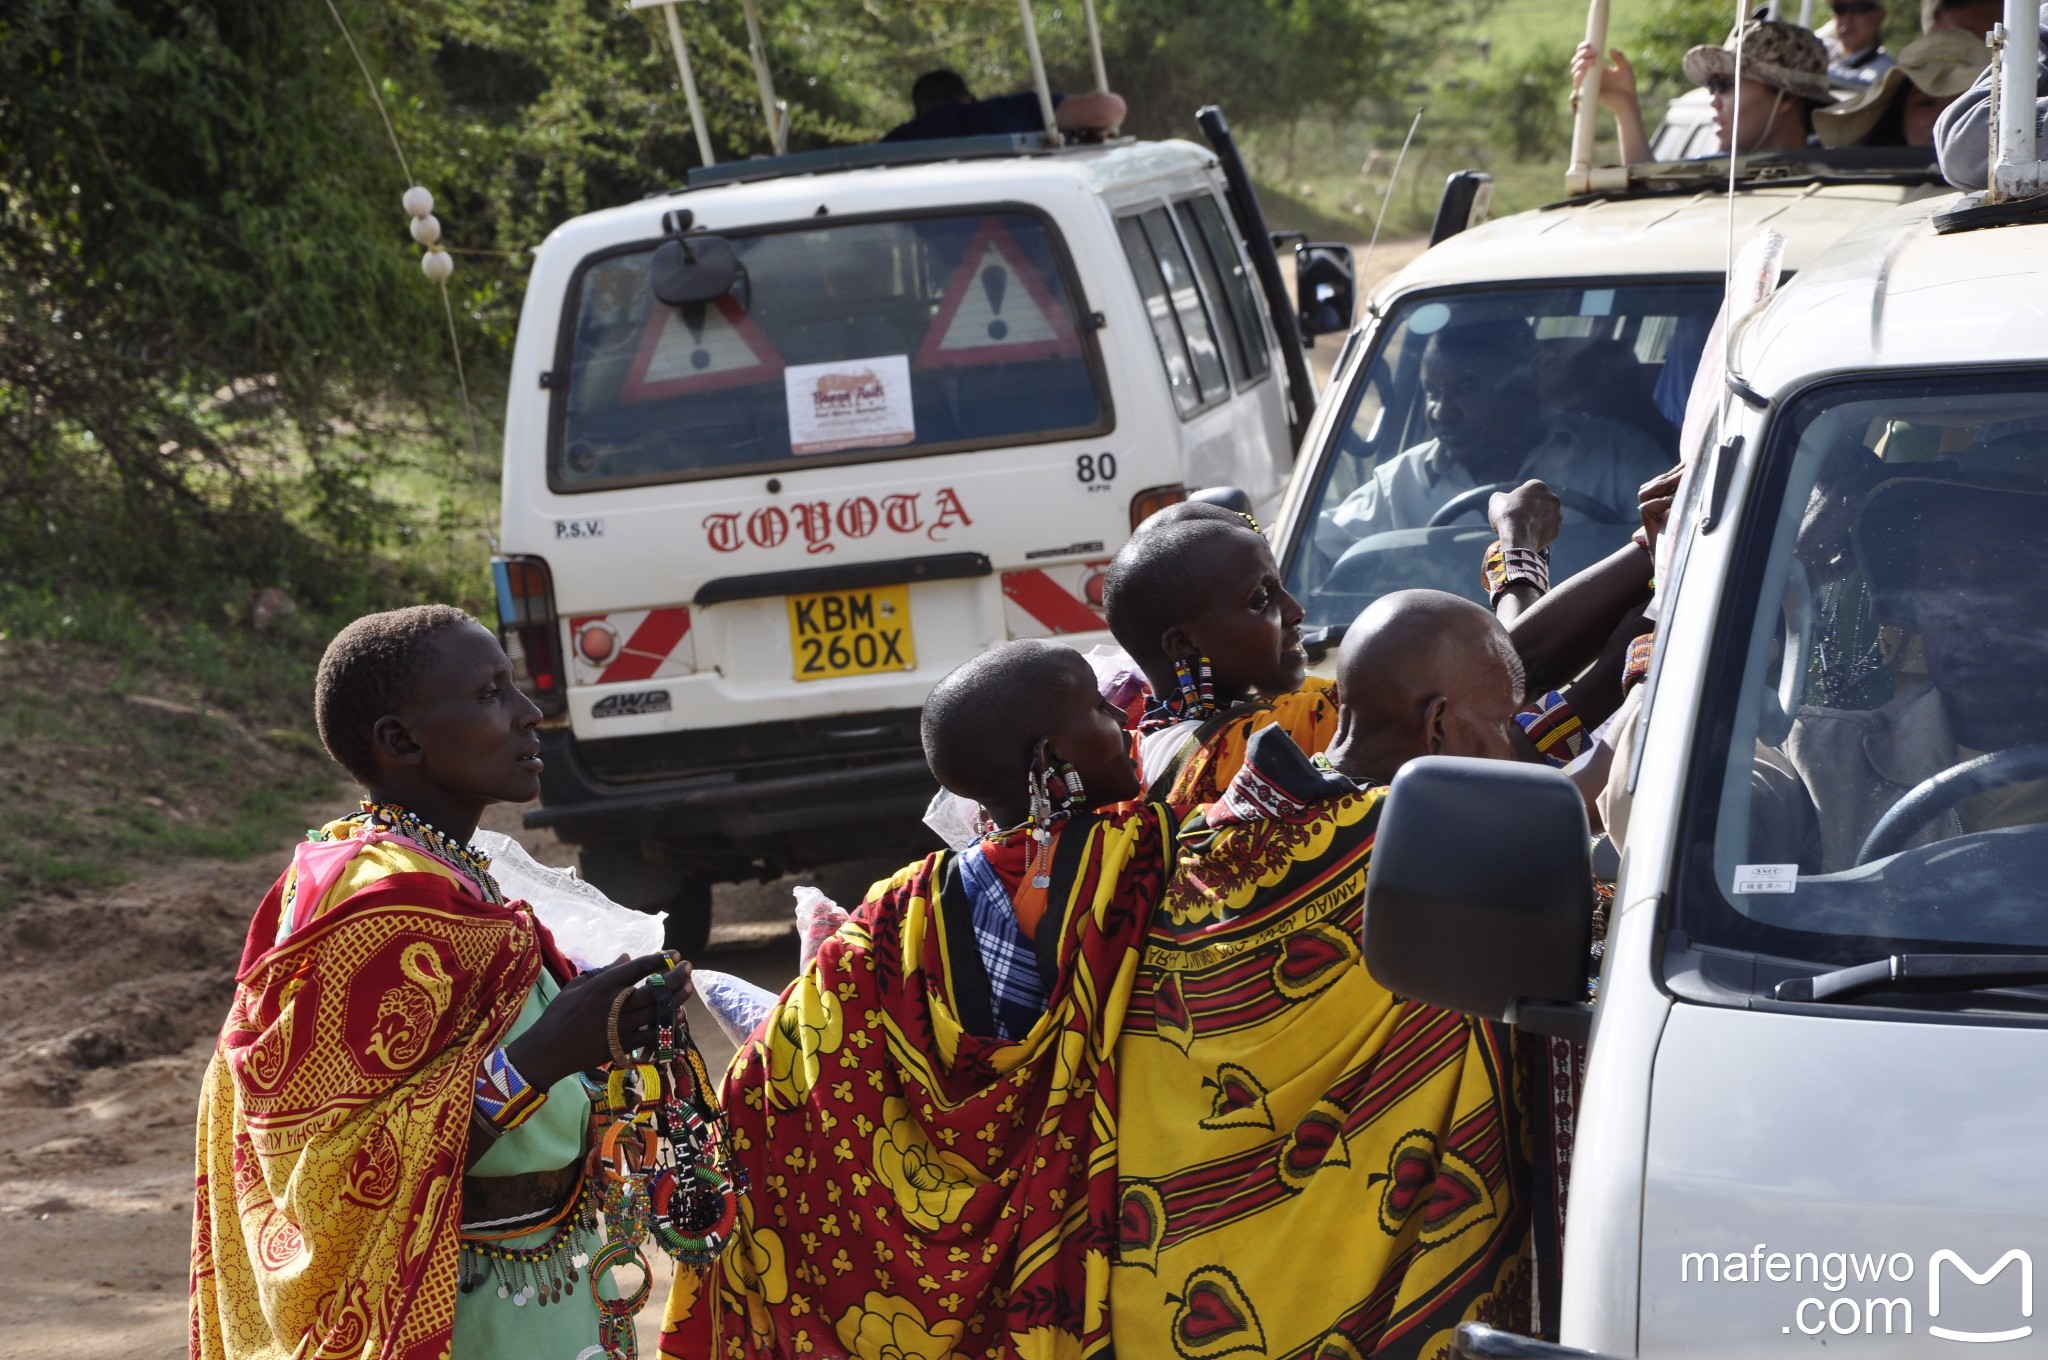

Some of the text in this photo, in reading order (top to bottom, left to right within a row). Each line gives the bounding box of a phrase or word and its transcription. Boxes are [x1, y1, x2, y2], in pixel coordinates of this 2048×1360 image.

[1076, 452, 1117, 483] 80
[555, 520, 603, 539] P.S.V.
[702, 487, 974, 554] TOYOTA
[794, 593, 875, 636] KBM
[802, 628, 905, 673] 260X
